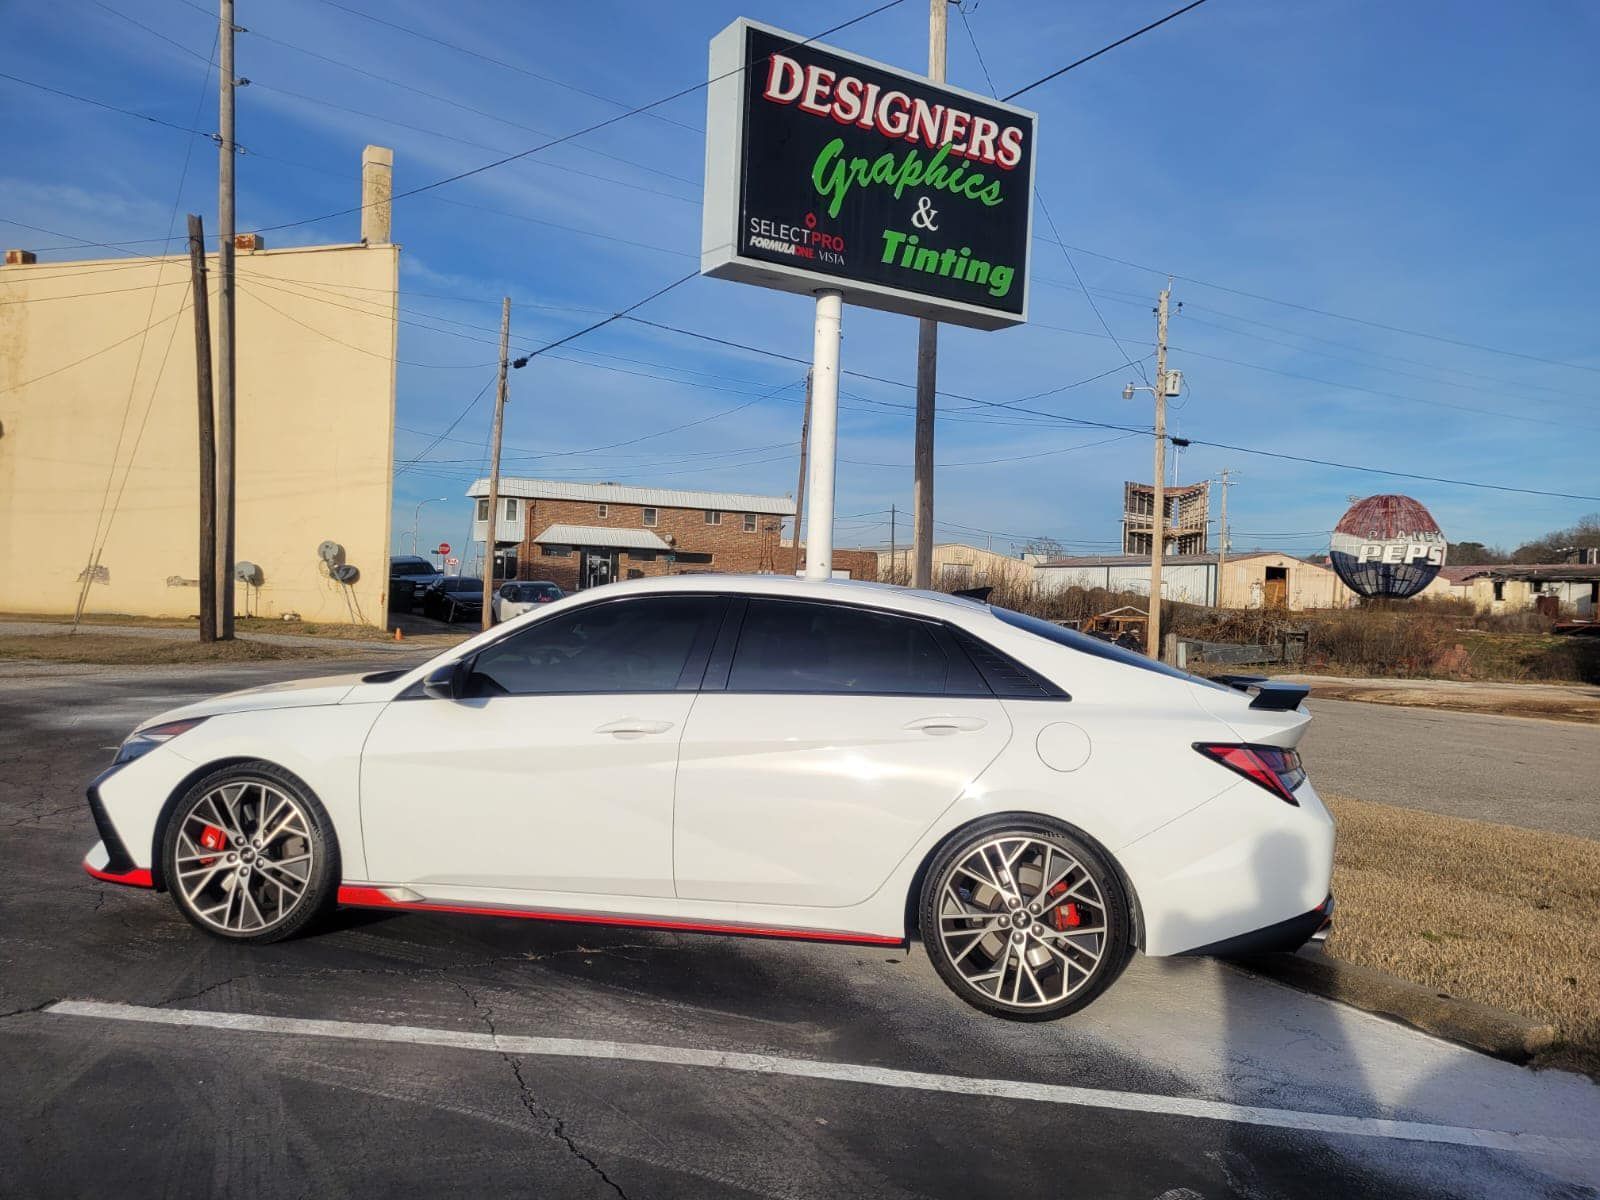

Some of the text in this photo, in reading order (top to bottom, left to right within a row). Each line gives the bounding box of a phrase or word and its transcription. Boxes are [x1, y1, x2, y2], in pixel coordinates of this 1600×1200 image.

[763, 52, 1024, 171] DESIGNERS
[811, 137, 1004, 219] Graphics
[910, 196, 939, 231] &
[818, 249, 845, 266] VISTA
[880, 229, 1015, 297] Tinting
